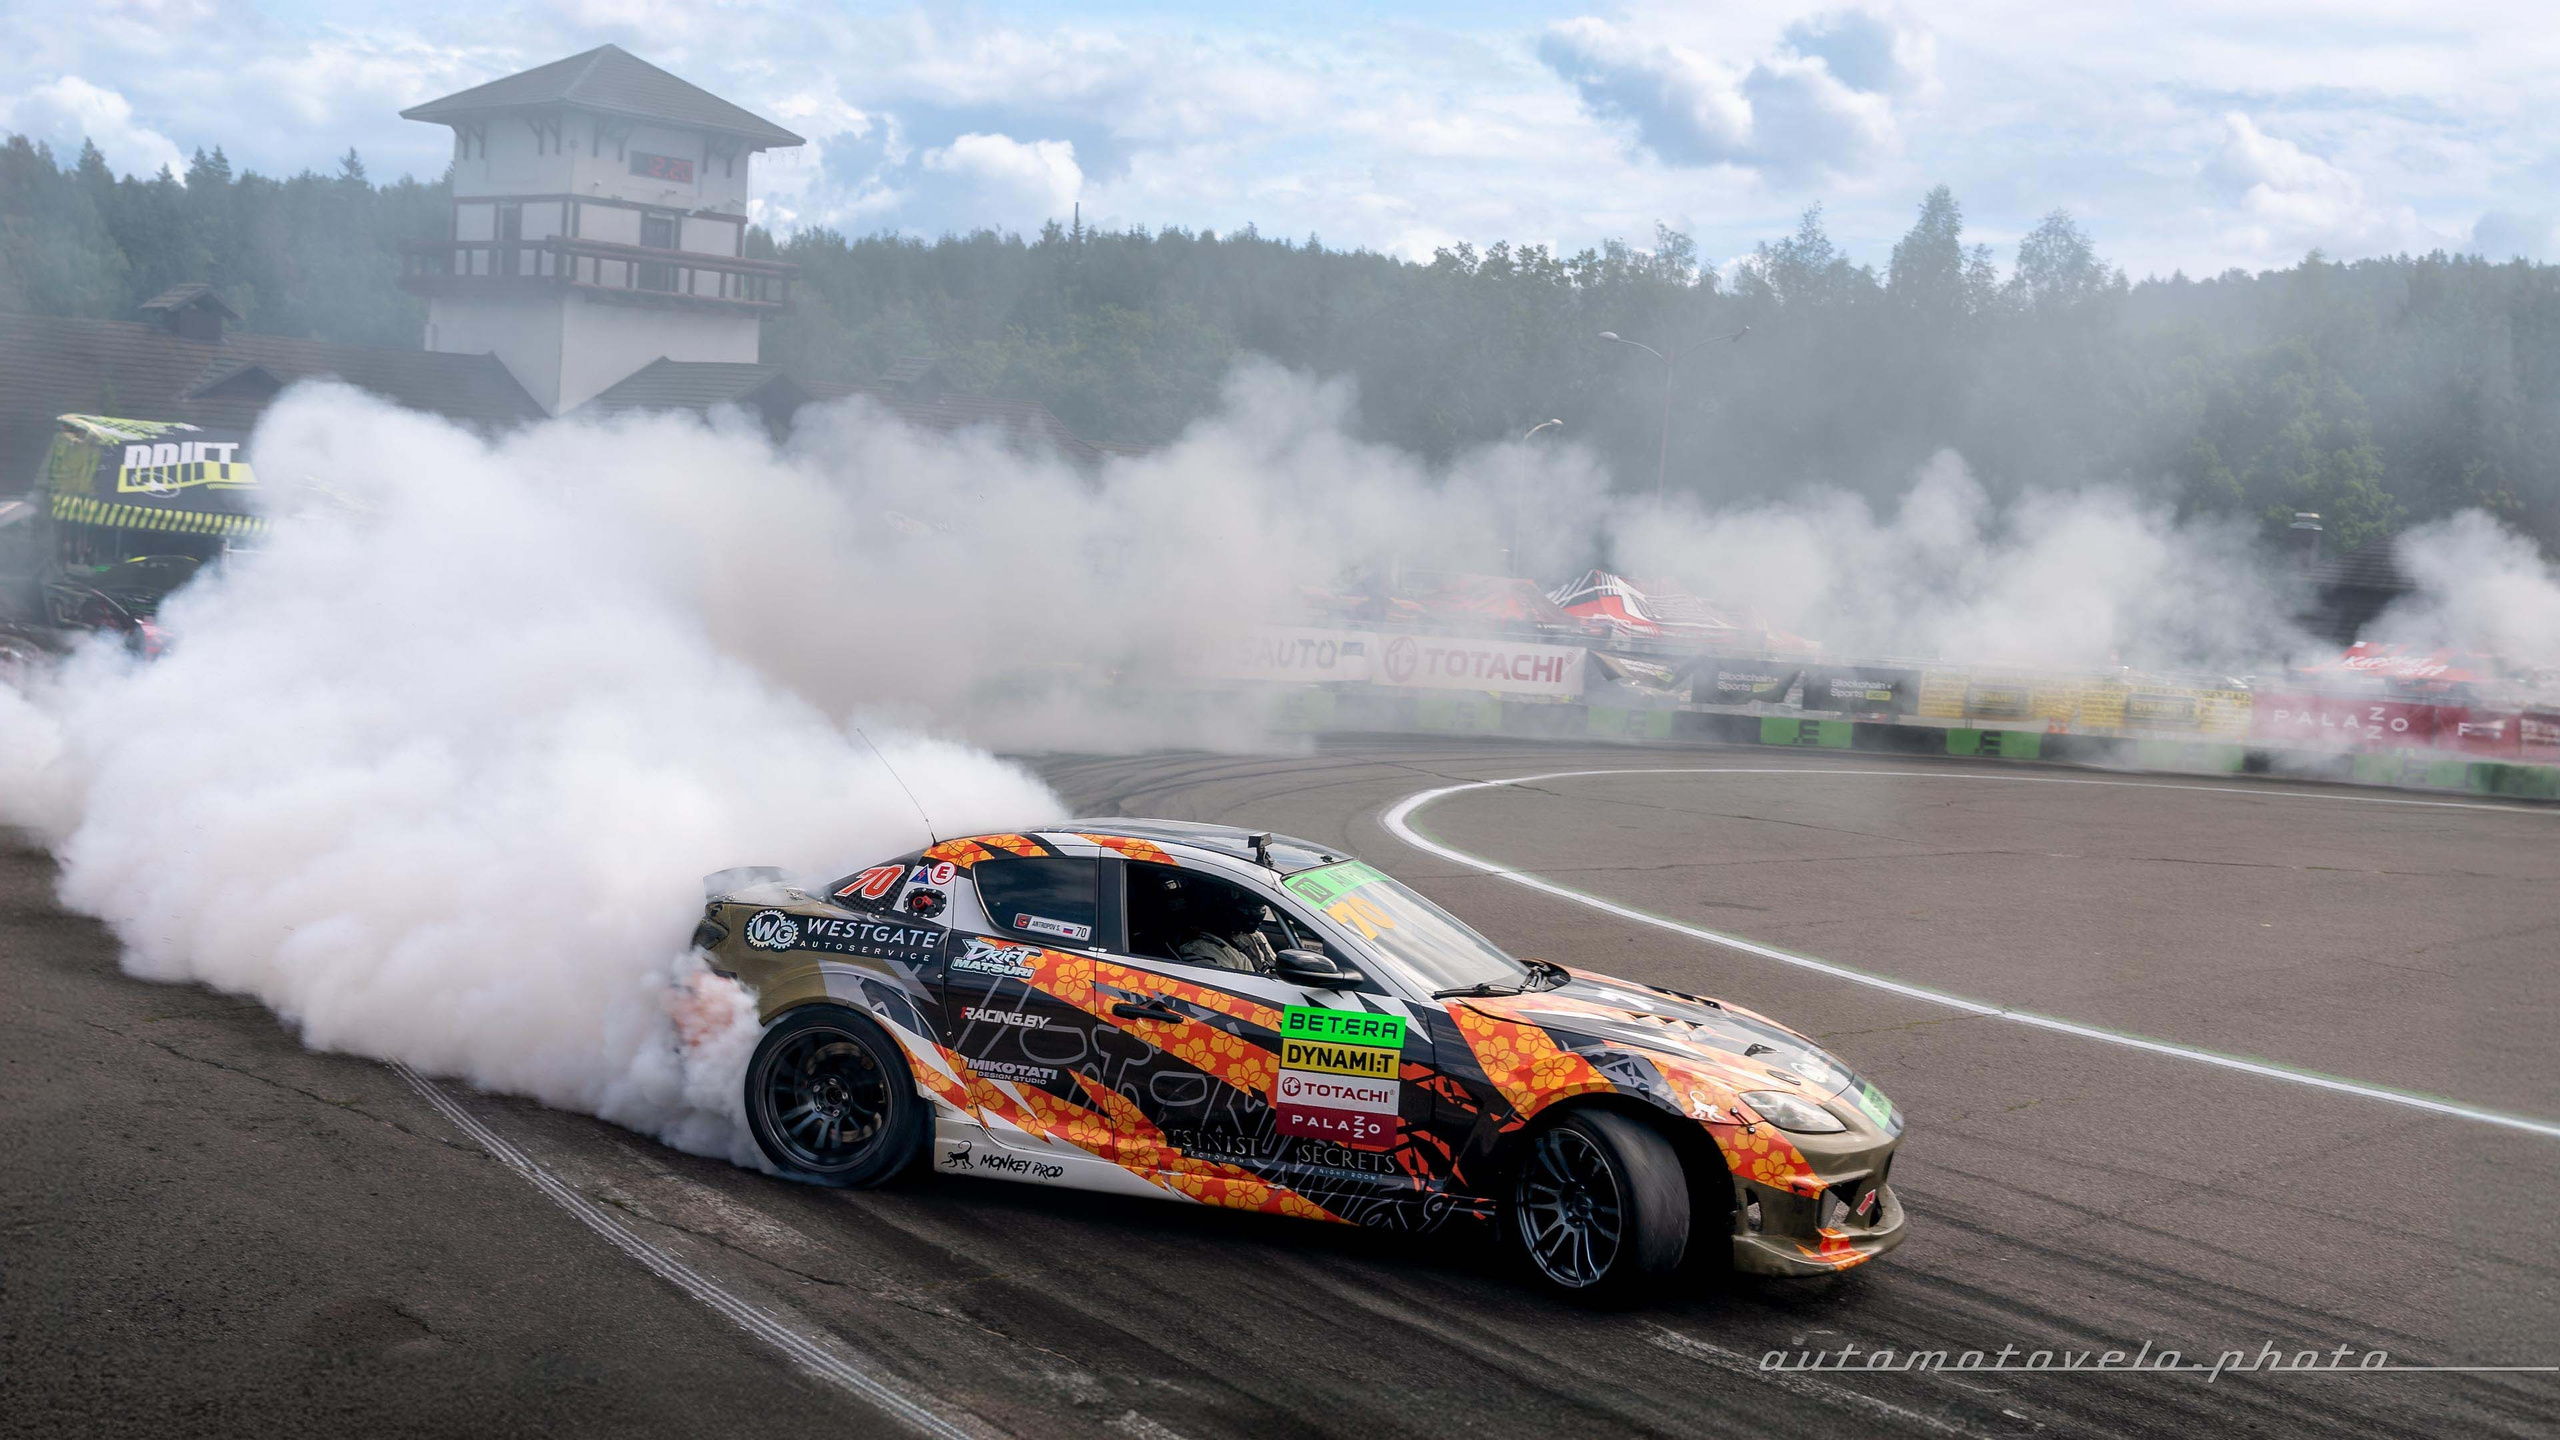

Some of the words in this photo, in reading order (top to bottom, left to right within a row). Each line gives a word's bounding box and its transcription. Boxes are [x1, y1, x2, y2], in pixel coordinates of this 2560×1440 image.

[123, 441, 239, 487] DRIFT
[1425, 648, 1564, 683] TOTACHI
[1717, 681, 1751, 692] Sports
[1830, 688, 1864, 698] Sports
[1831, 679, 1886, 690] Blockchain
[834, 864, 905, 900] 70
[936, 866, 951, 880] E
[1298, 881, 1328, 900] 70
[1032, 921, 1056, 931] ANTROPOV
[1327, 896, 1396, 940] 70
[808, 918, 938, 948] WESTGATE
[1076, 926, 1087, 938] 70
[800, 941, 931, 962] AUTOSERVICE
[953, 958, 1034, 978] MATSURI
[968, 1058, 1058, 1079] MIKOTATI
[978, 1071, 1011, 1080] DESIGN
[1013, 1075, 1047, 1085] STUDIO
[1304, 1082, 1388, 1103] TOTACHI
[1292, 1115, 1381, 1139] PALAZZO
[980, 1154, 1031, 1174] MONKEY
[1032, 1161, 1063, 1179] PROD
[1301, 1144, 1395, 1173] SECRETS
[1319, 1168, 1346, 1176] NIGHT
